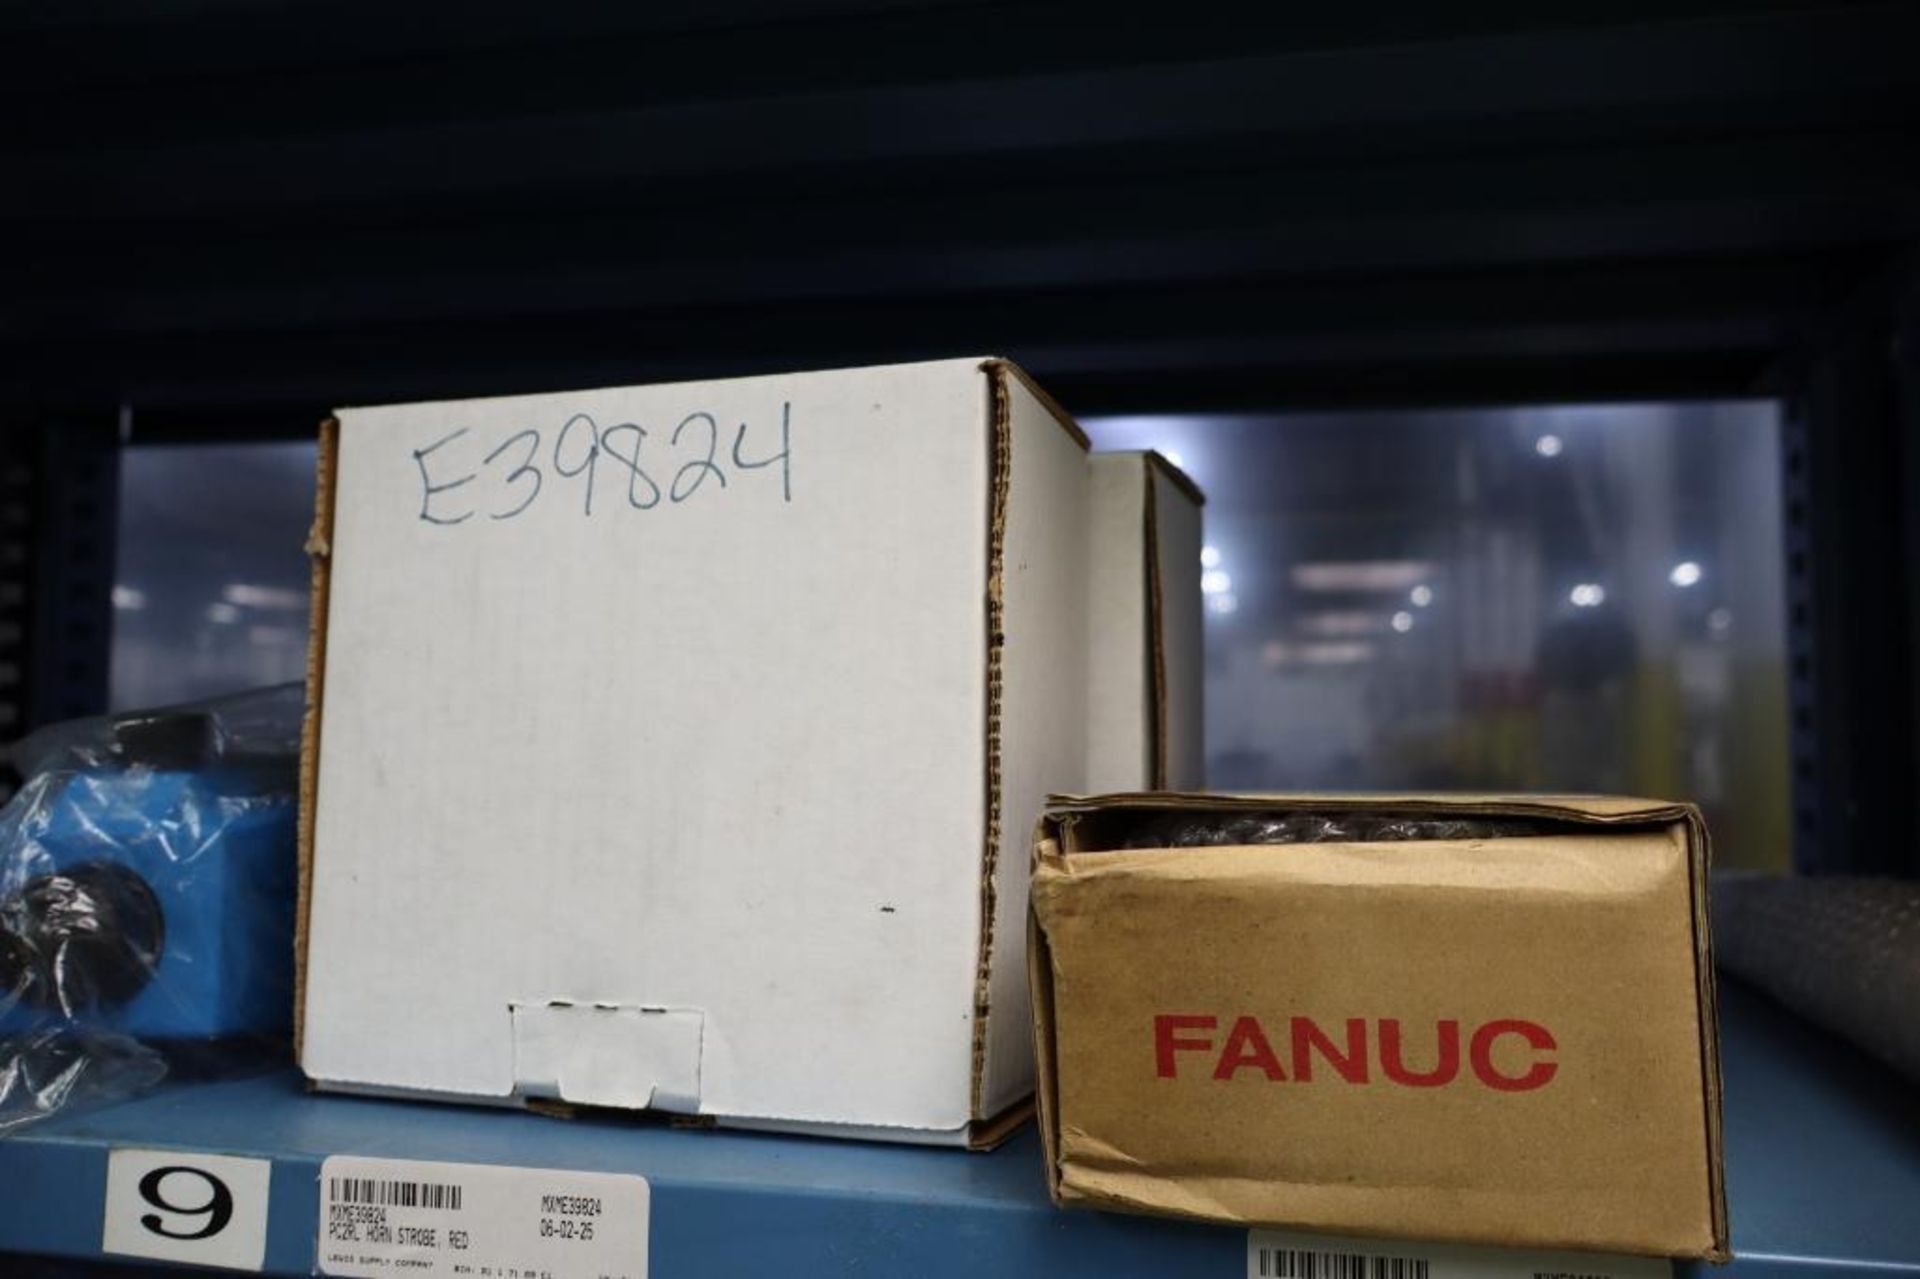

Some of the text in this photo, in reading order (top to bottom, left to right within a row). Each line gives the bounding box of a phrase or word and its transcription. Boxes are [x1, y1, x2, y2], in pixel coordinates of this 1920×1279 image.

[414, 401, 791, 524] E39824
[1154, 1015, 1558, 1092] FANUC
[138, 1166, 233, 1240] 9
[541, 1195, 602, 1216] MXME39824
[366, 1226, 392, 1244] HORN
[449, 1230, 469, 1250] RED
[395, 1259, 433, 1269] COMPANY
